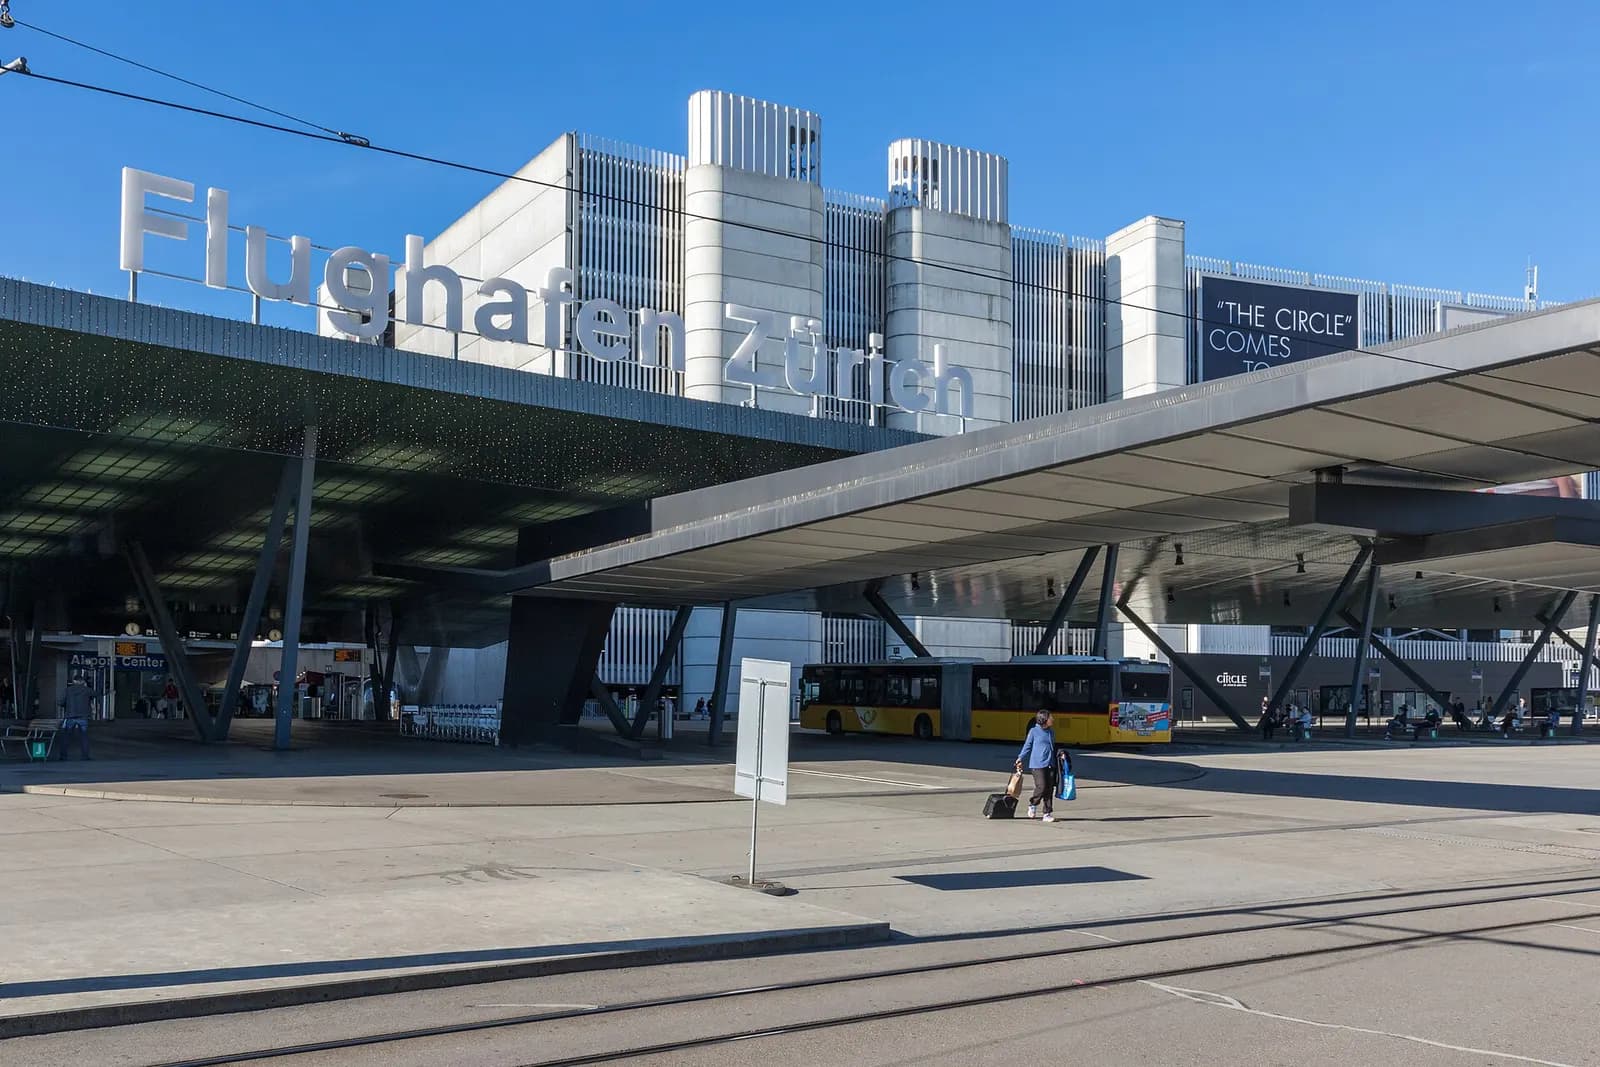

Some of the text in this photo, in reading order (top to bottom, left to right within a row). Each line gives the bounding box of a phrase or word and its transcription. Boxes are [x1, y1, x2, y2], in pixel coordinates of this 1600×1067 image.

[120, 166, 975, 419] Flughafen Zürich
[1209, 329, 1291, 358] COMES
[122, 657, 165, 668] Center
